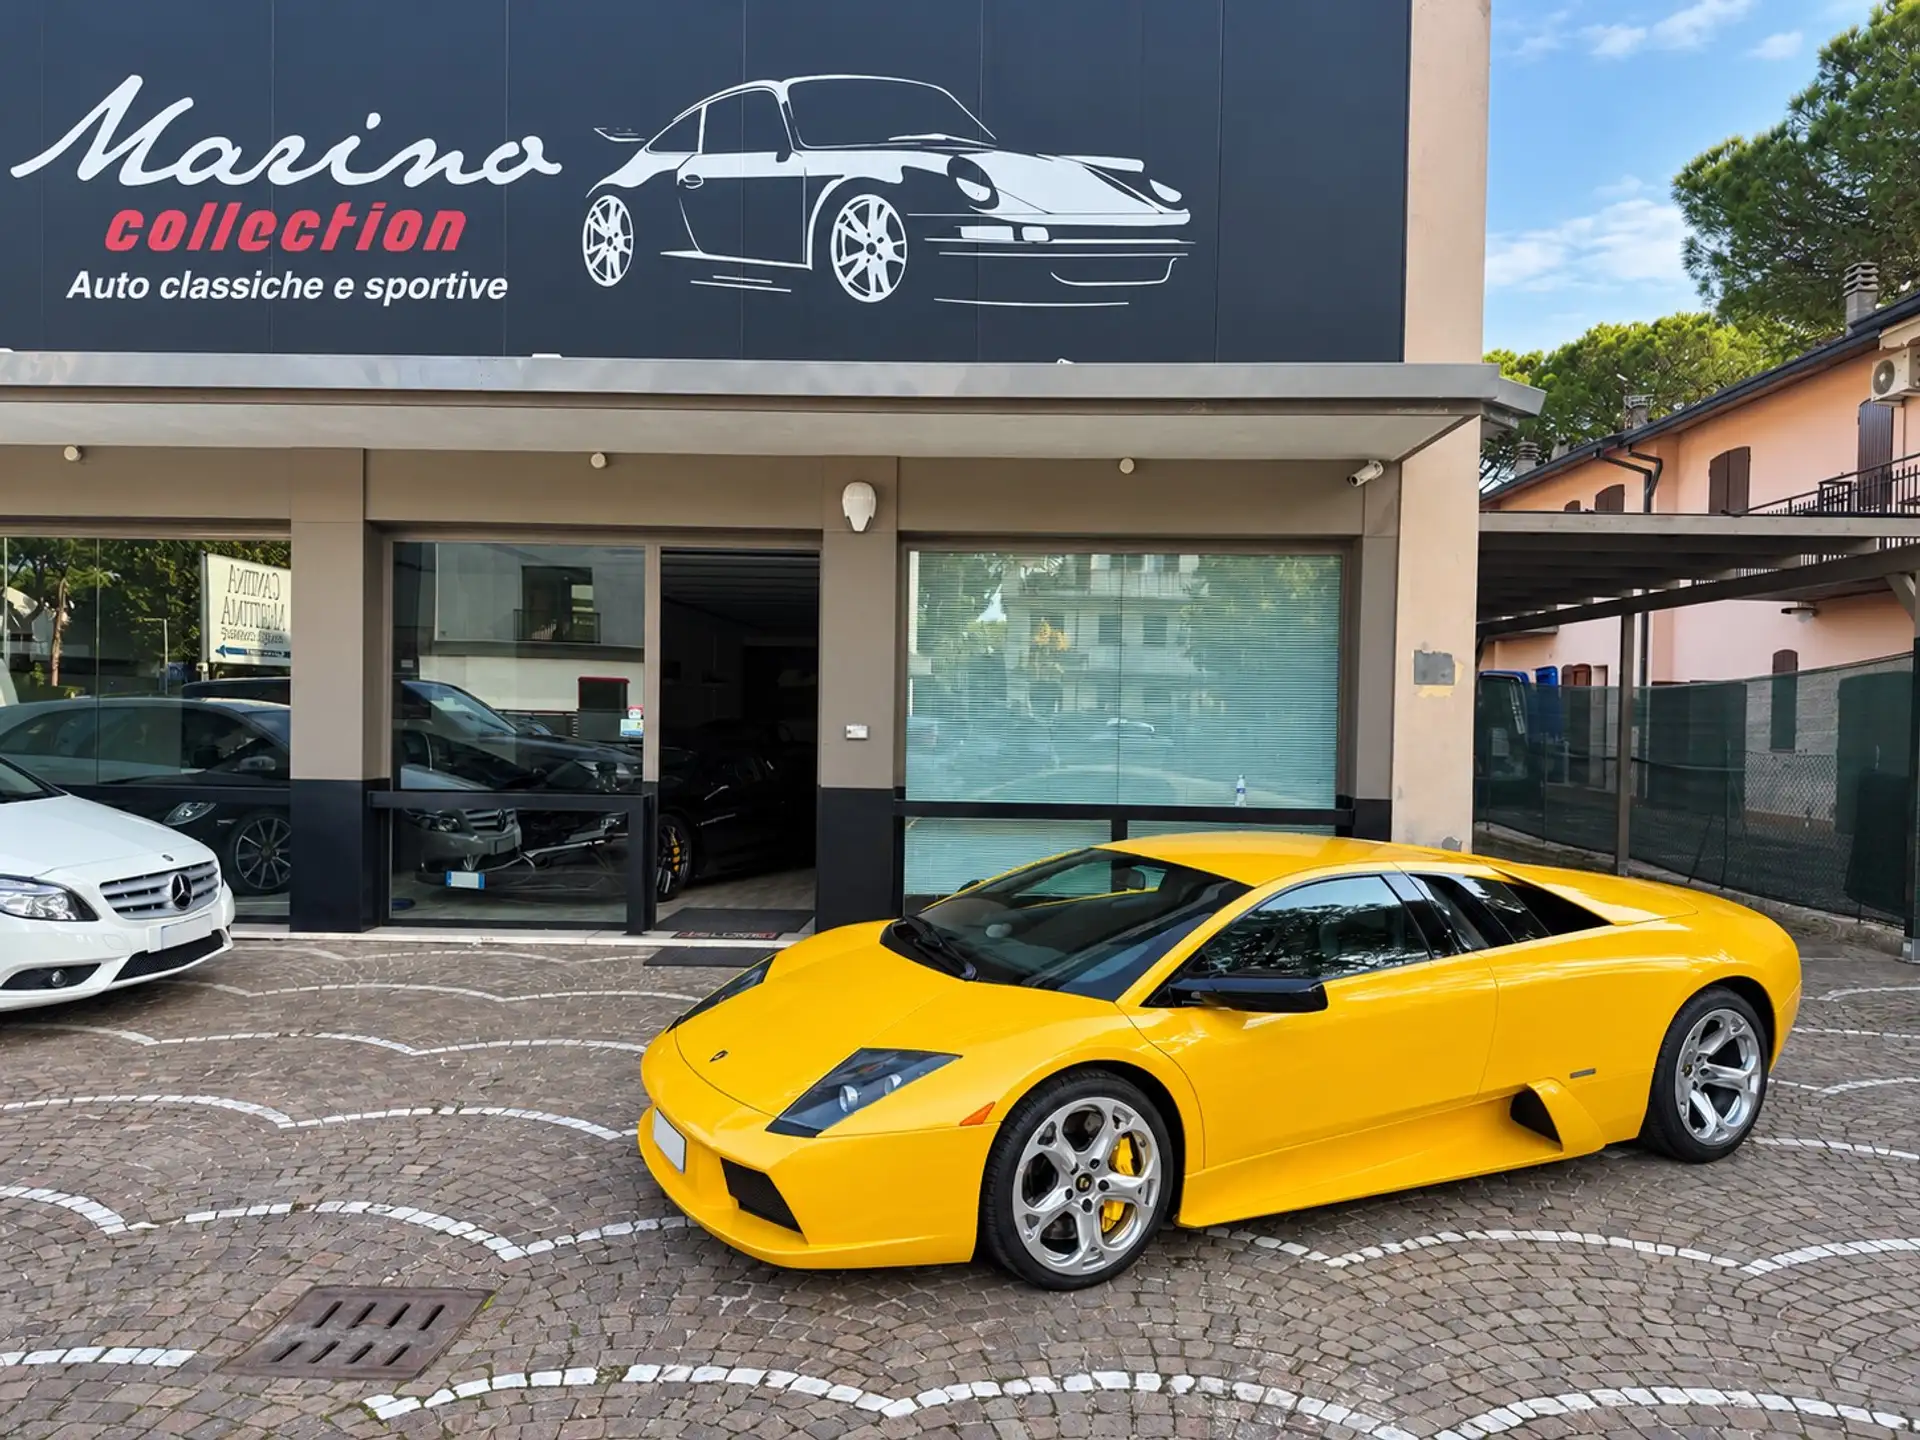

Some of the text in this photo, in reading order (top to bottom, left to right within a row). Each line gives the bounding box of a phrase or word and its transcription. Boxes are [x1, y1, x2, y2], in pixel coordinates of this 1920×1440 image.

[11, 75, 562, 187] Marino
[105, 202, 466, 251] collection
[67, 271, 507, 306] Auto classiche e sportive
